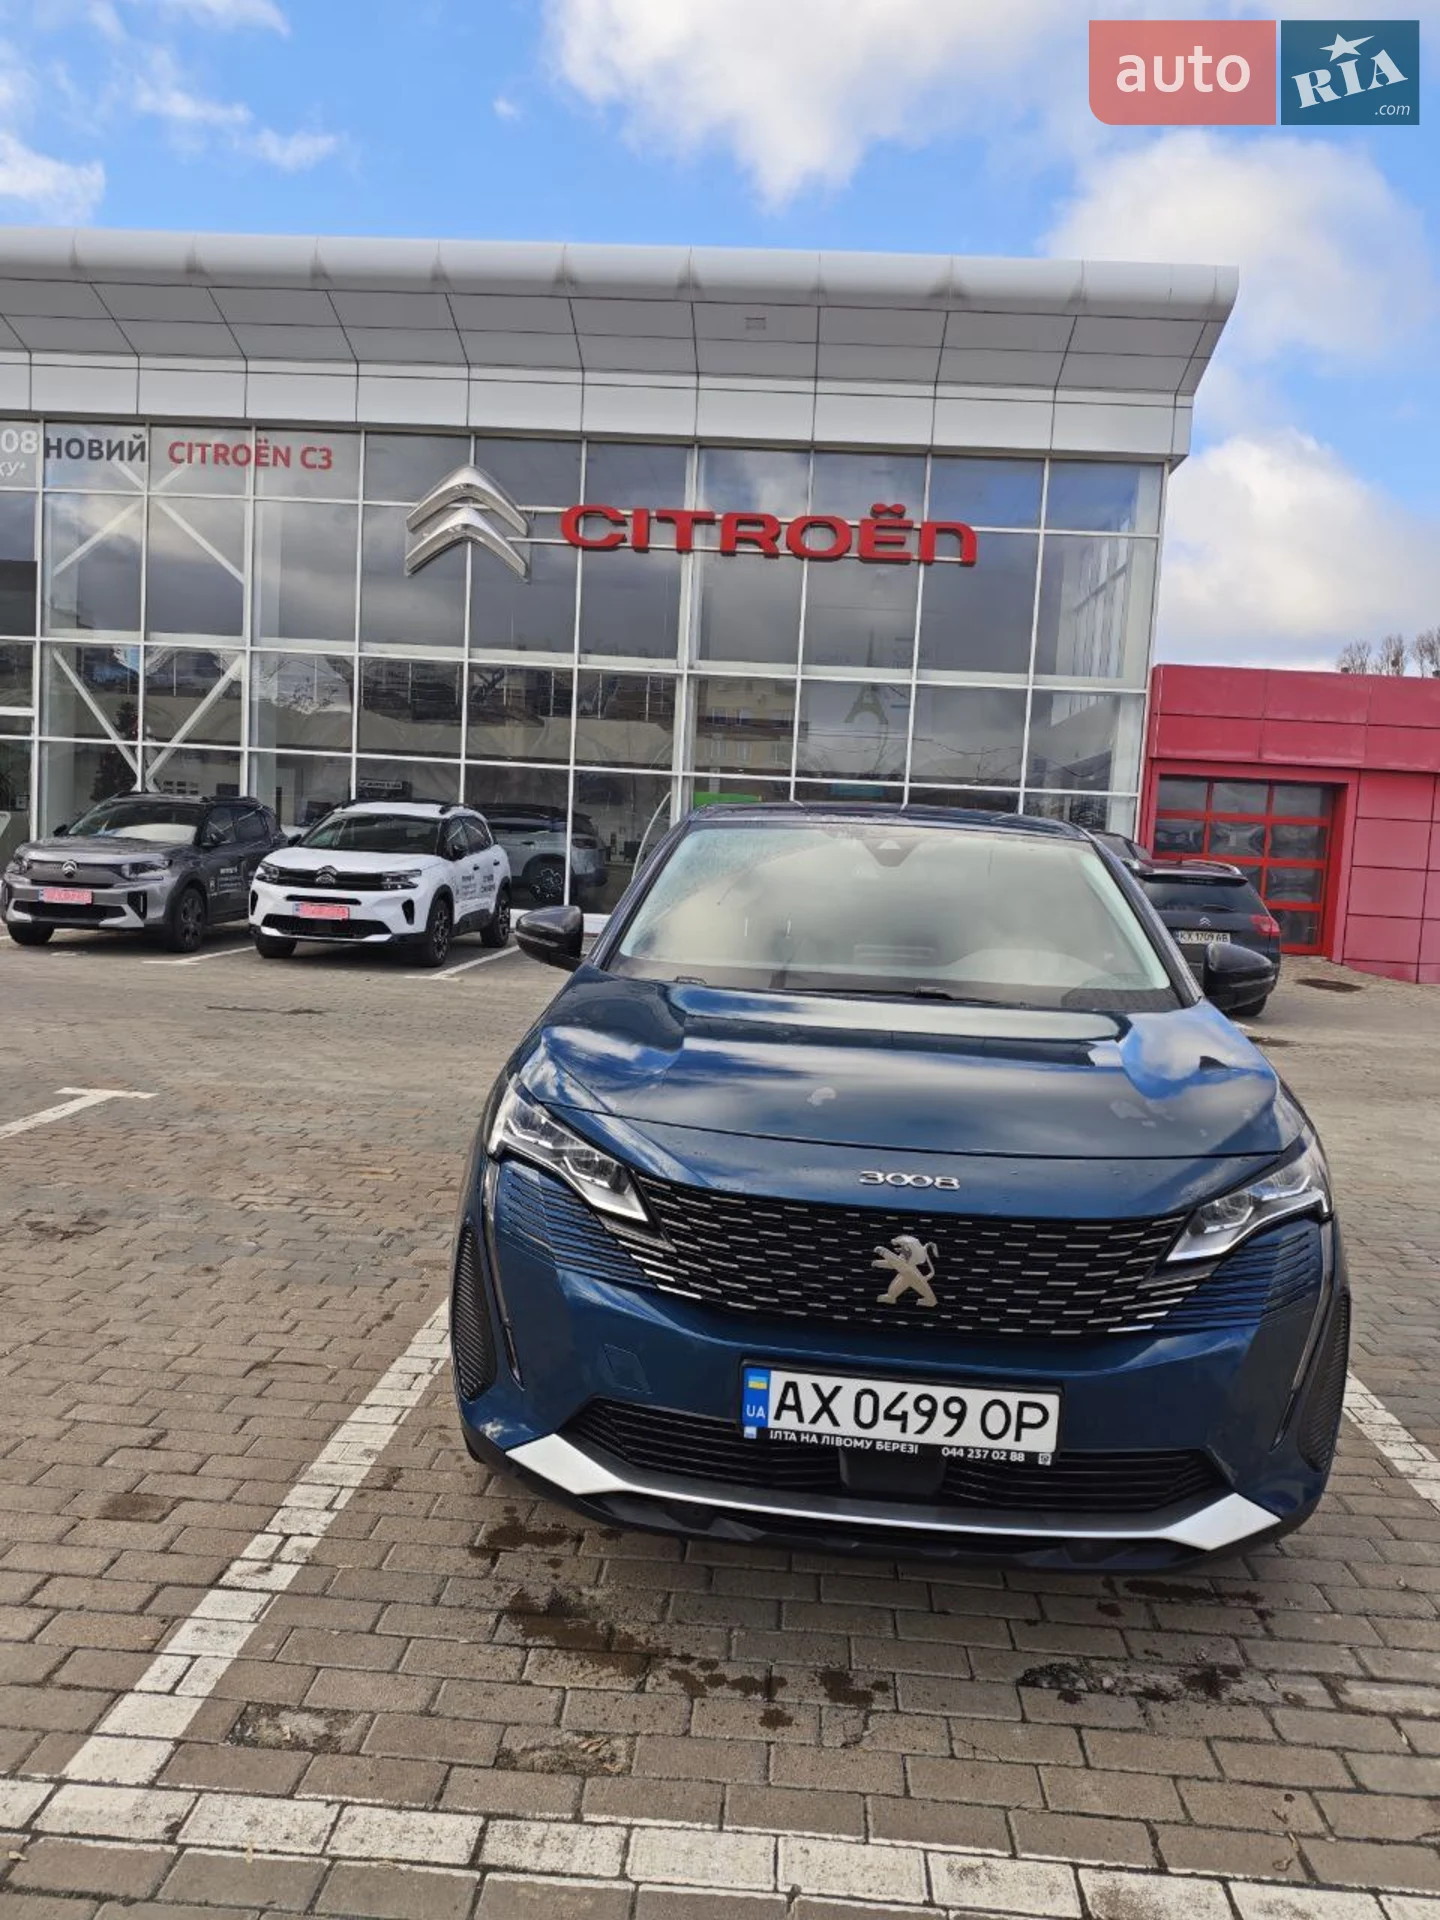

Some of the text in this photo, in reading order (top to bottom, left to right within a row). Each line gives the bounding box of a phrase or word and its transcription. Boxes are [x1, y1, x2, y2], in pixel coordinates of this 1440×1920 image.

[44, 434, 146, 462] НОВИЙ
[168, 439, 332, 470] CITROËN C3
[859, 1170, 960, 1190] 3008
[746, 1404, 766, 1420] UA
[774, 1381, 1049, 1442] AX 0499 OP
[769, 1430, 918, 1454] ІЛТА НА ЛІВОМУ БЕРЕЗІ
[941, 1447, 1025, 1462] 044 237 02 88
